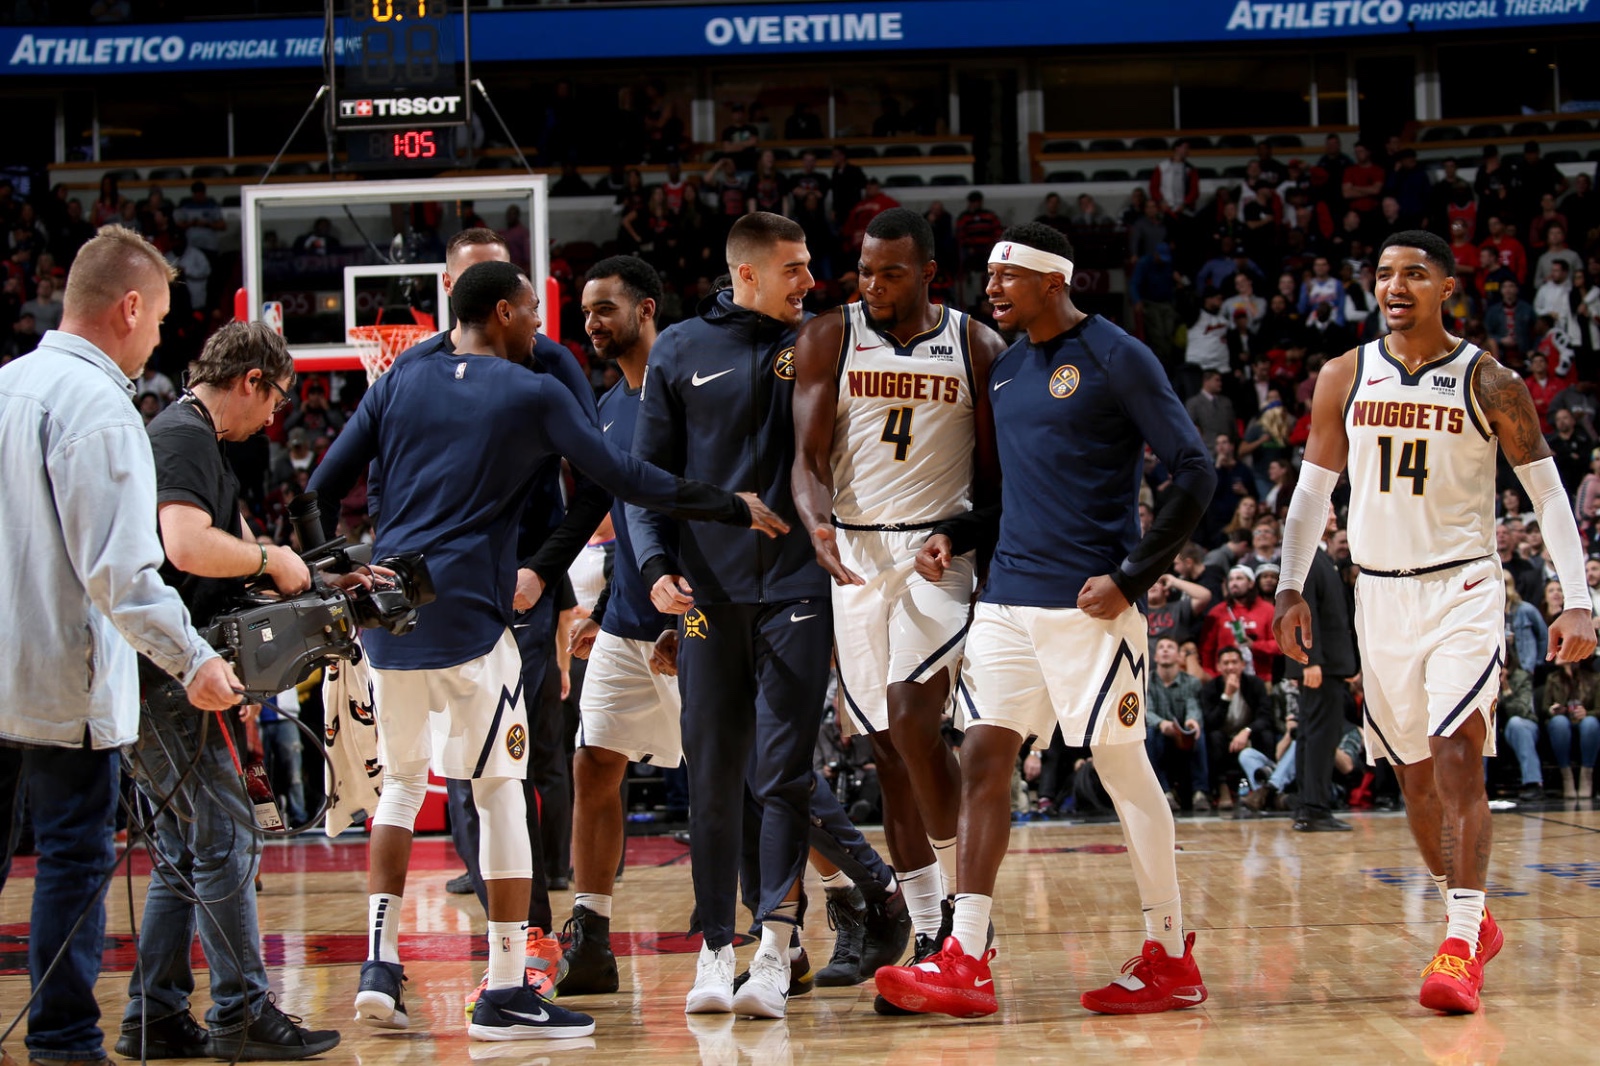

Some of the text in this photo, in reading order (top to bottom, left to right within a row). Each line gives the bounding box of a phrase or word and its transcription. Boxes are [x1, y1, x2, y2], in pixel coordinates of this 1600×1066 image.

[705, 12, 903, 46] OVERTIME
[1226, 0, 1590, 30] ATHLETICO PHYSICAL THERAPY
[9, 34, 185, 65] ATHLETICO
[188, 38, 278, 61] PHYSICAL
[374, 96, 461, 116] TISSOT
[394, 131, 436, 158] 1:05
[930, 345, 953, 355] WU
[848, 370, 960, 404] NUGGETS
[1433, 375, 1457, 389] WU
[1353, 400, 1465, 434] NUGGETS
[880, 406, 915, 462] 4
[1376, 435, 1430, 496] 14
